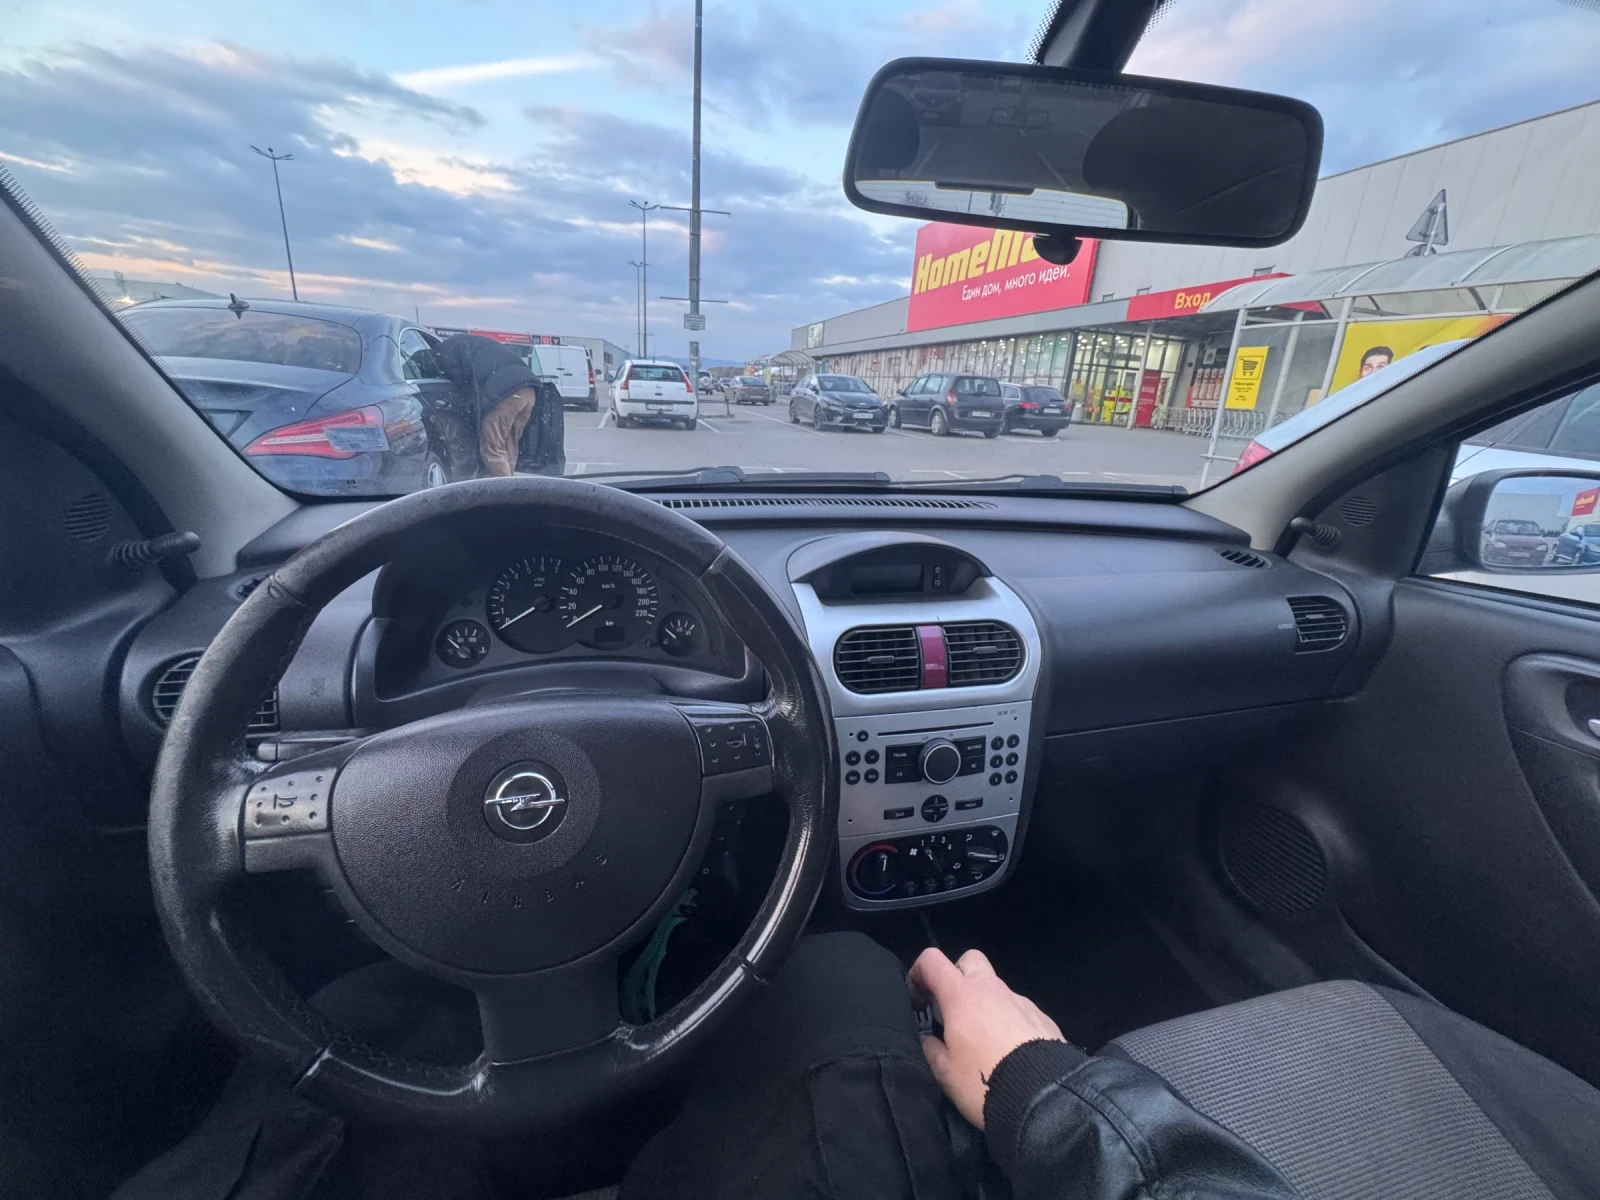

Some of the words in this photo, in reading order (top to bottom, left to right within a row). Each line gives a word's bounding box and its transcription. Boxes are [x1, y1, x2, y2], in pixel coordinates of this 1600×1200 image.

[914, 229, 1041, 295] HomeMa
[962, 285, 981, 301] Един
[981, 282, 1001, 298] дом,
[1004, 273, 1036, 291] много
[1174, 292, 1211, 310] Вход
[586, 568, 595, 576] 80
[598, 564, 608, 572] 100
[612, 564, 622, 572] 120
[568, 588, 578, 596] 40
[636, 587, 647, 595] 180
[568, 602, 577, 610] 20
[637, 598, 650, 606] 200
[635, 609, 648, 617] 220
